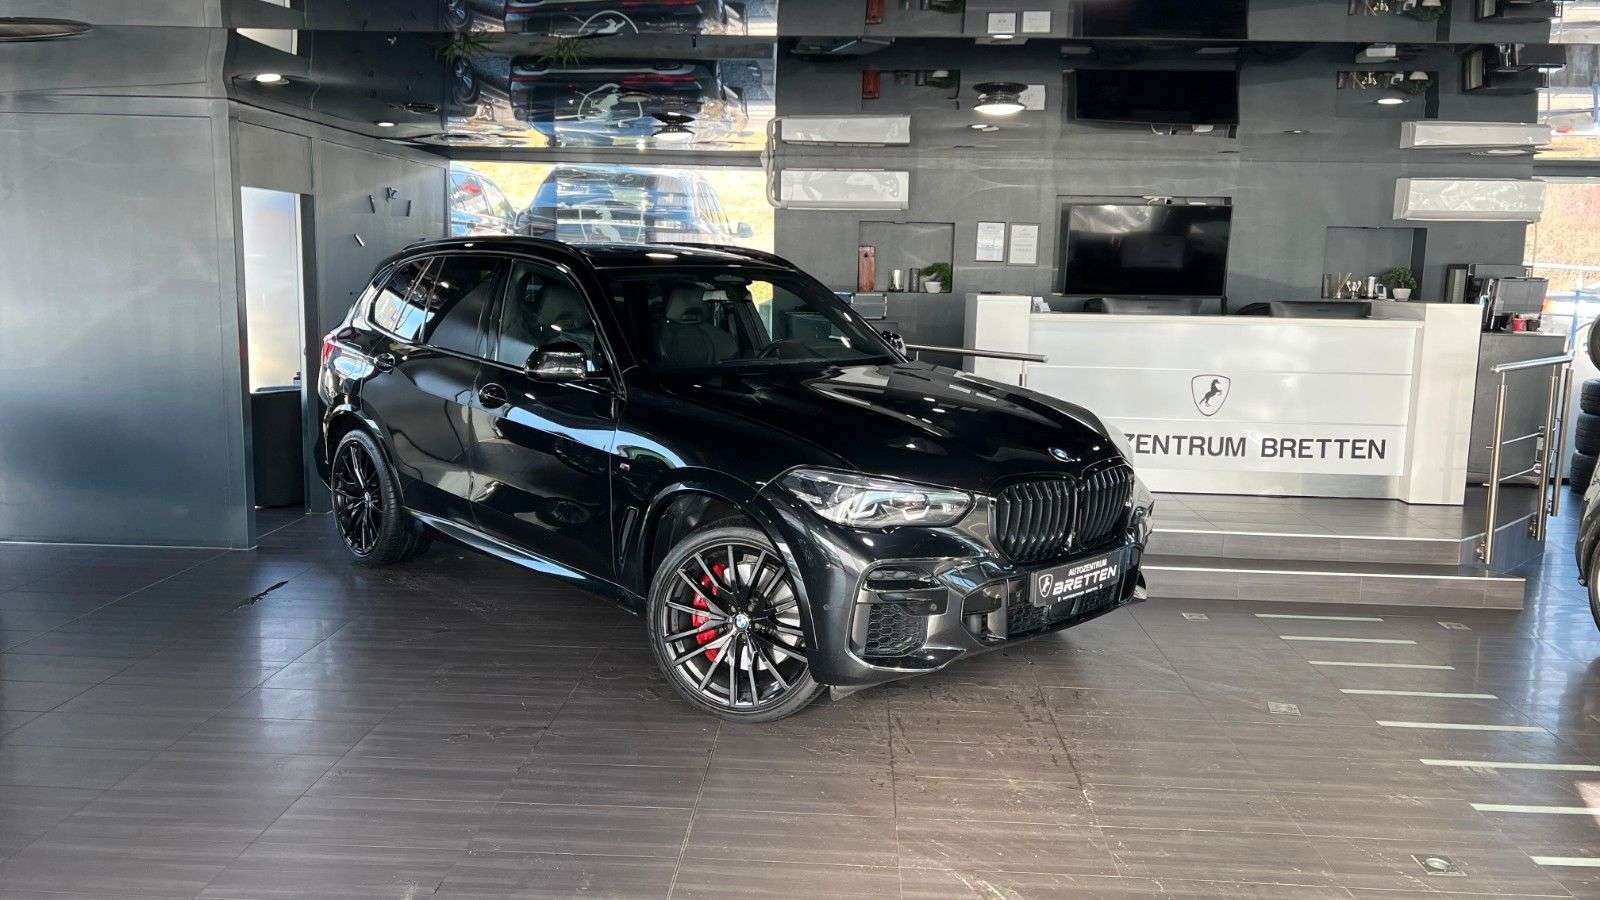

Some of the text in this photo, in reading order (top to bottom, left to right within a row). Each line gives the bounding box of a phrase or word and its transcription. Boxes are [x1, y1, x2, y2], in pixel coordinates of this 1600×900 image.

[1261, 437, 1386, 459] BRETTEN
[1068, 558, 1108, 576] AUTOZENTRUM
[1053, 564, 1118, 595] BRETTEN
